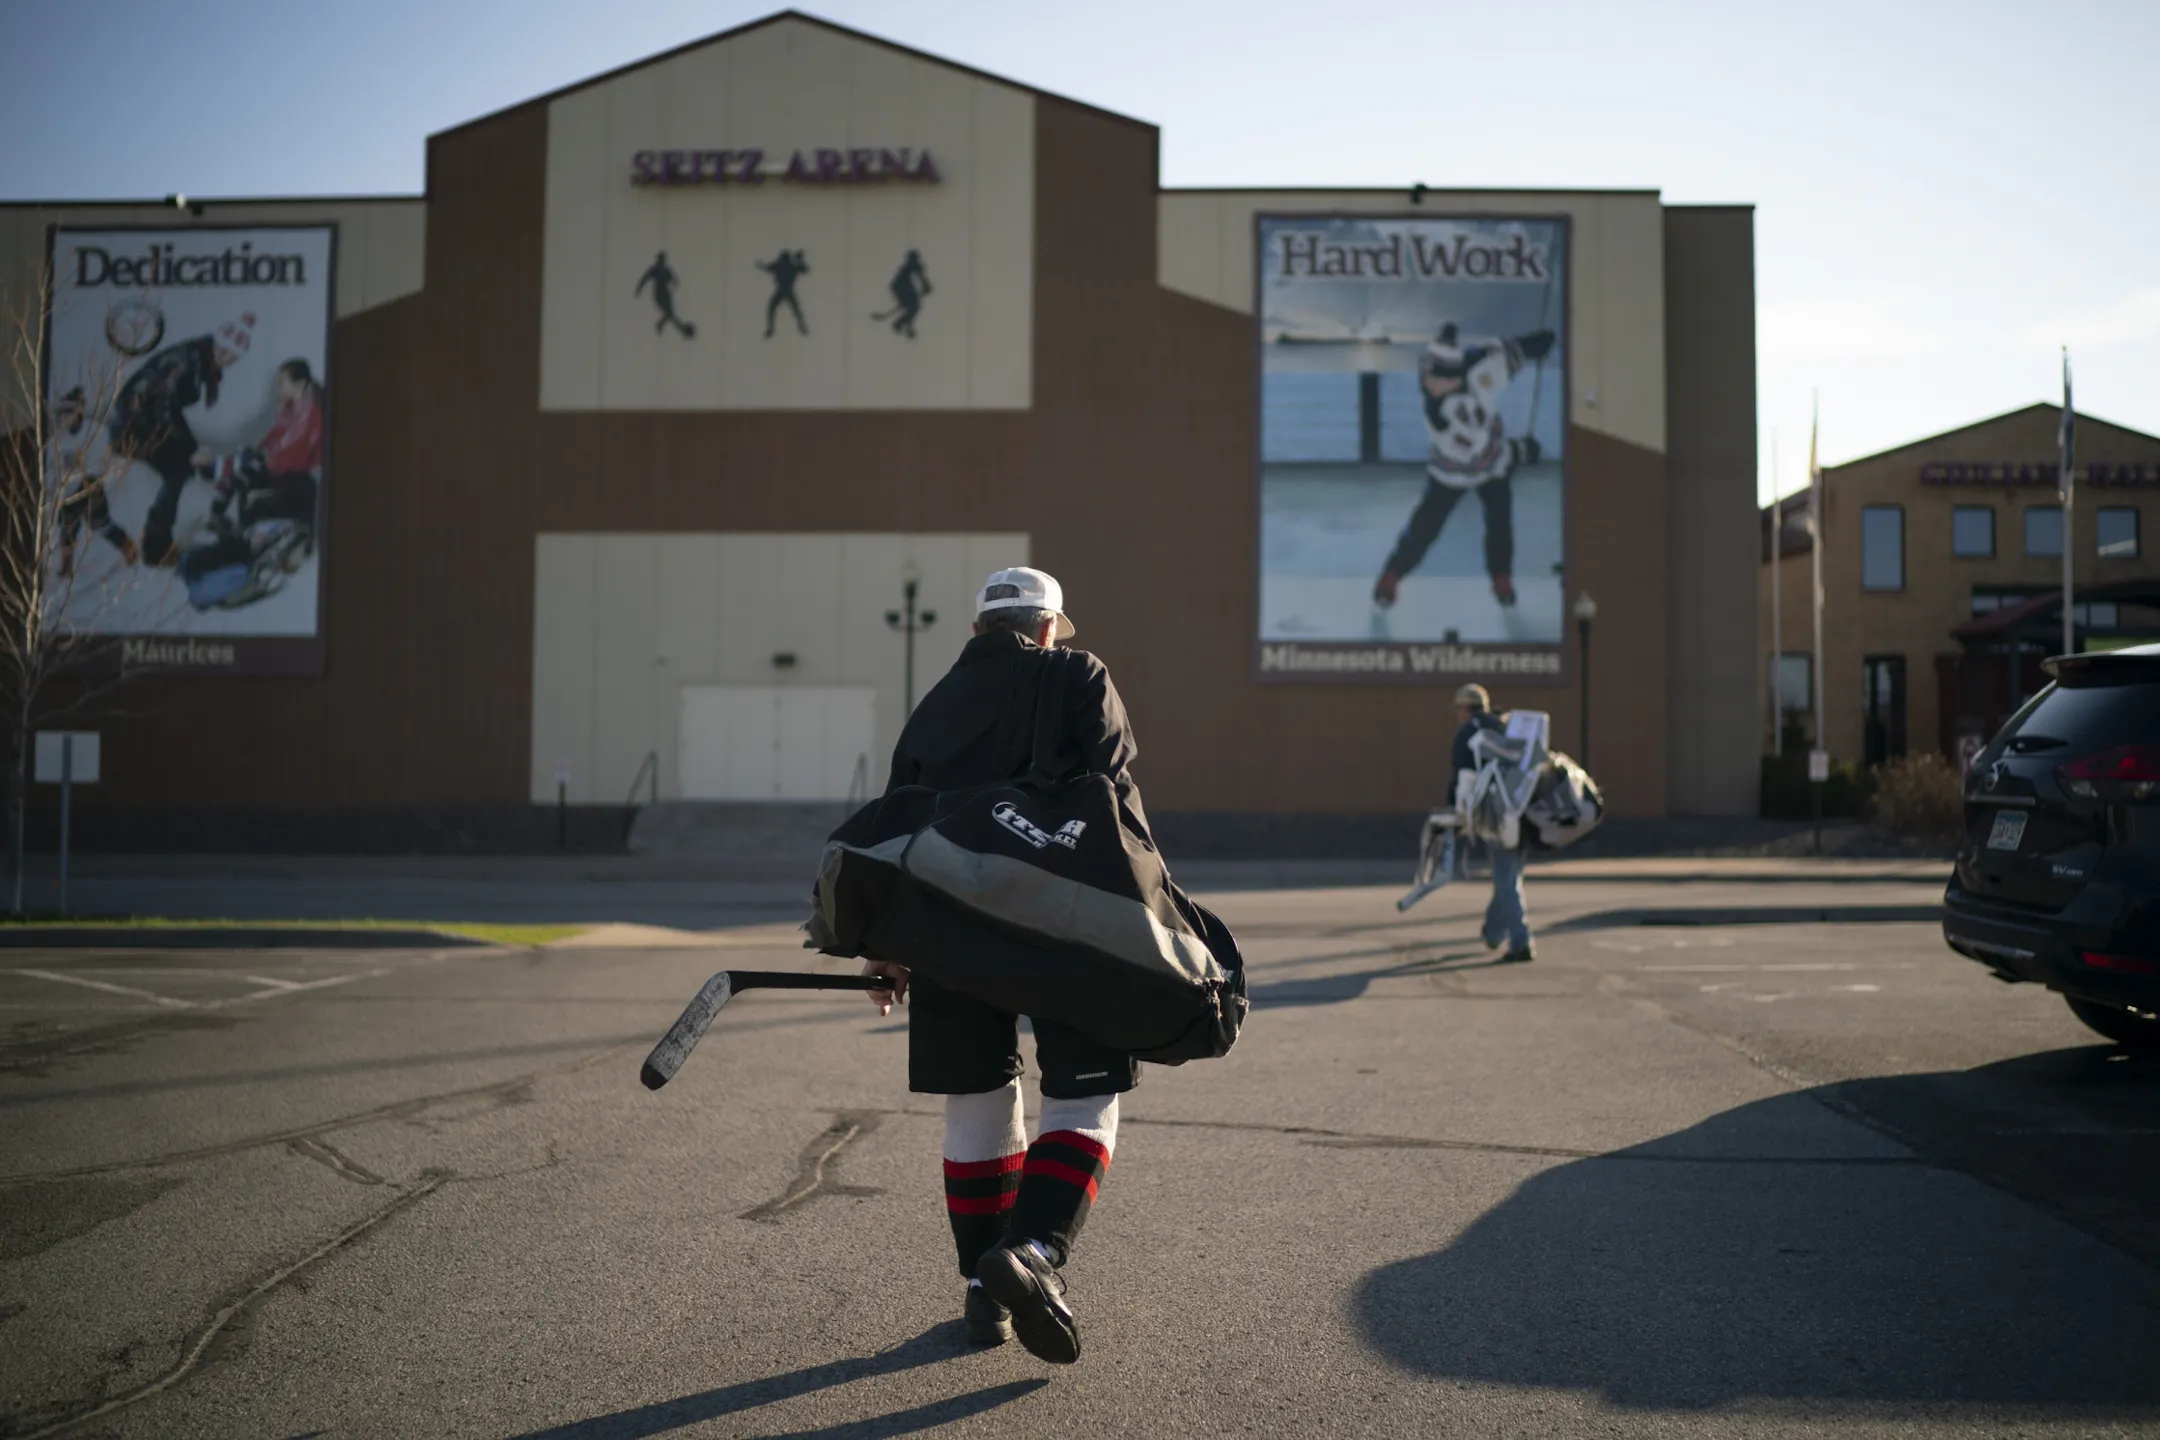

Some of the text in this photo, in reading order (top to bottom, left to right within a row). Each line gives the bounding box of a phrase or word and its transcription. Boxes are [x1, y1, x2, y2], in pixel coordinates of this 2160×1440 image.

[631, 149, 944, 185] SEITZ ARENA
[75, 240, 307, 288] Dedication
[1279, 233, 1546, 279] Hard Work
[122, 639, 236, 665] Maurices
[1261, 645, 1561, 673] Minnesota Wilderness
